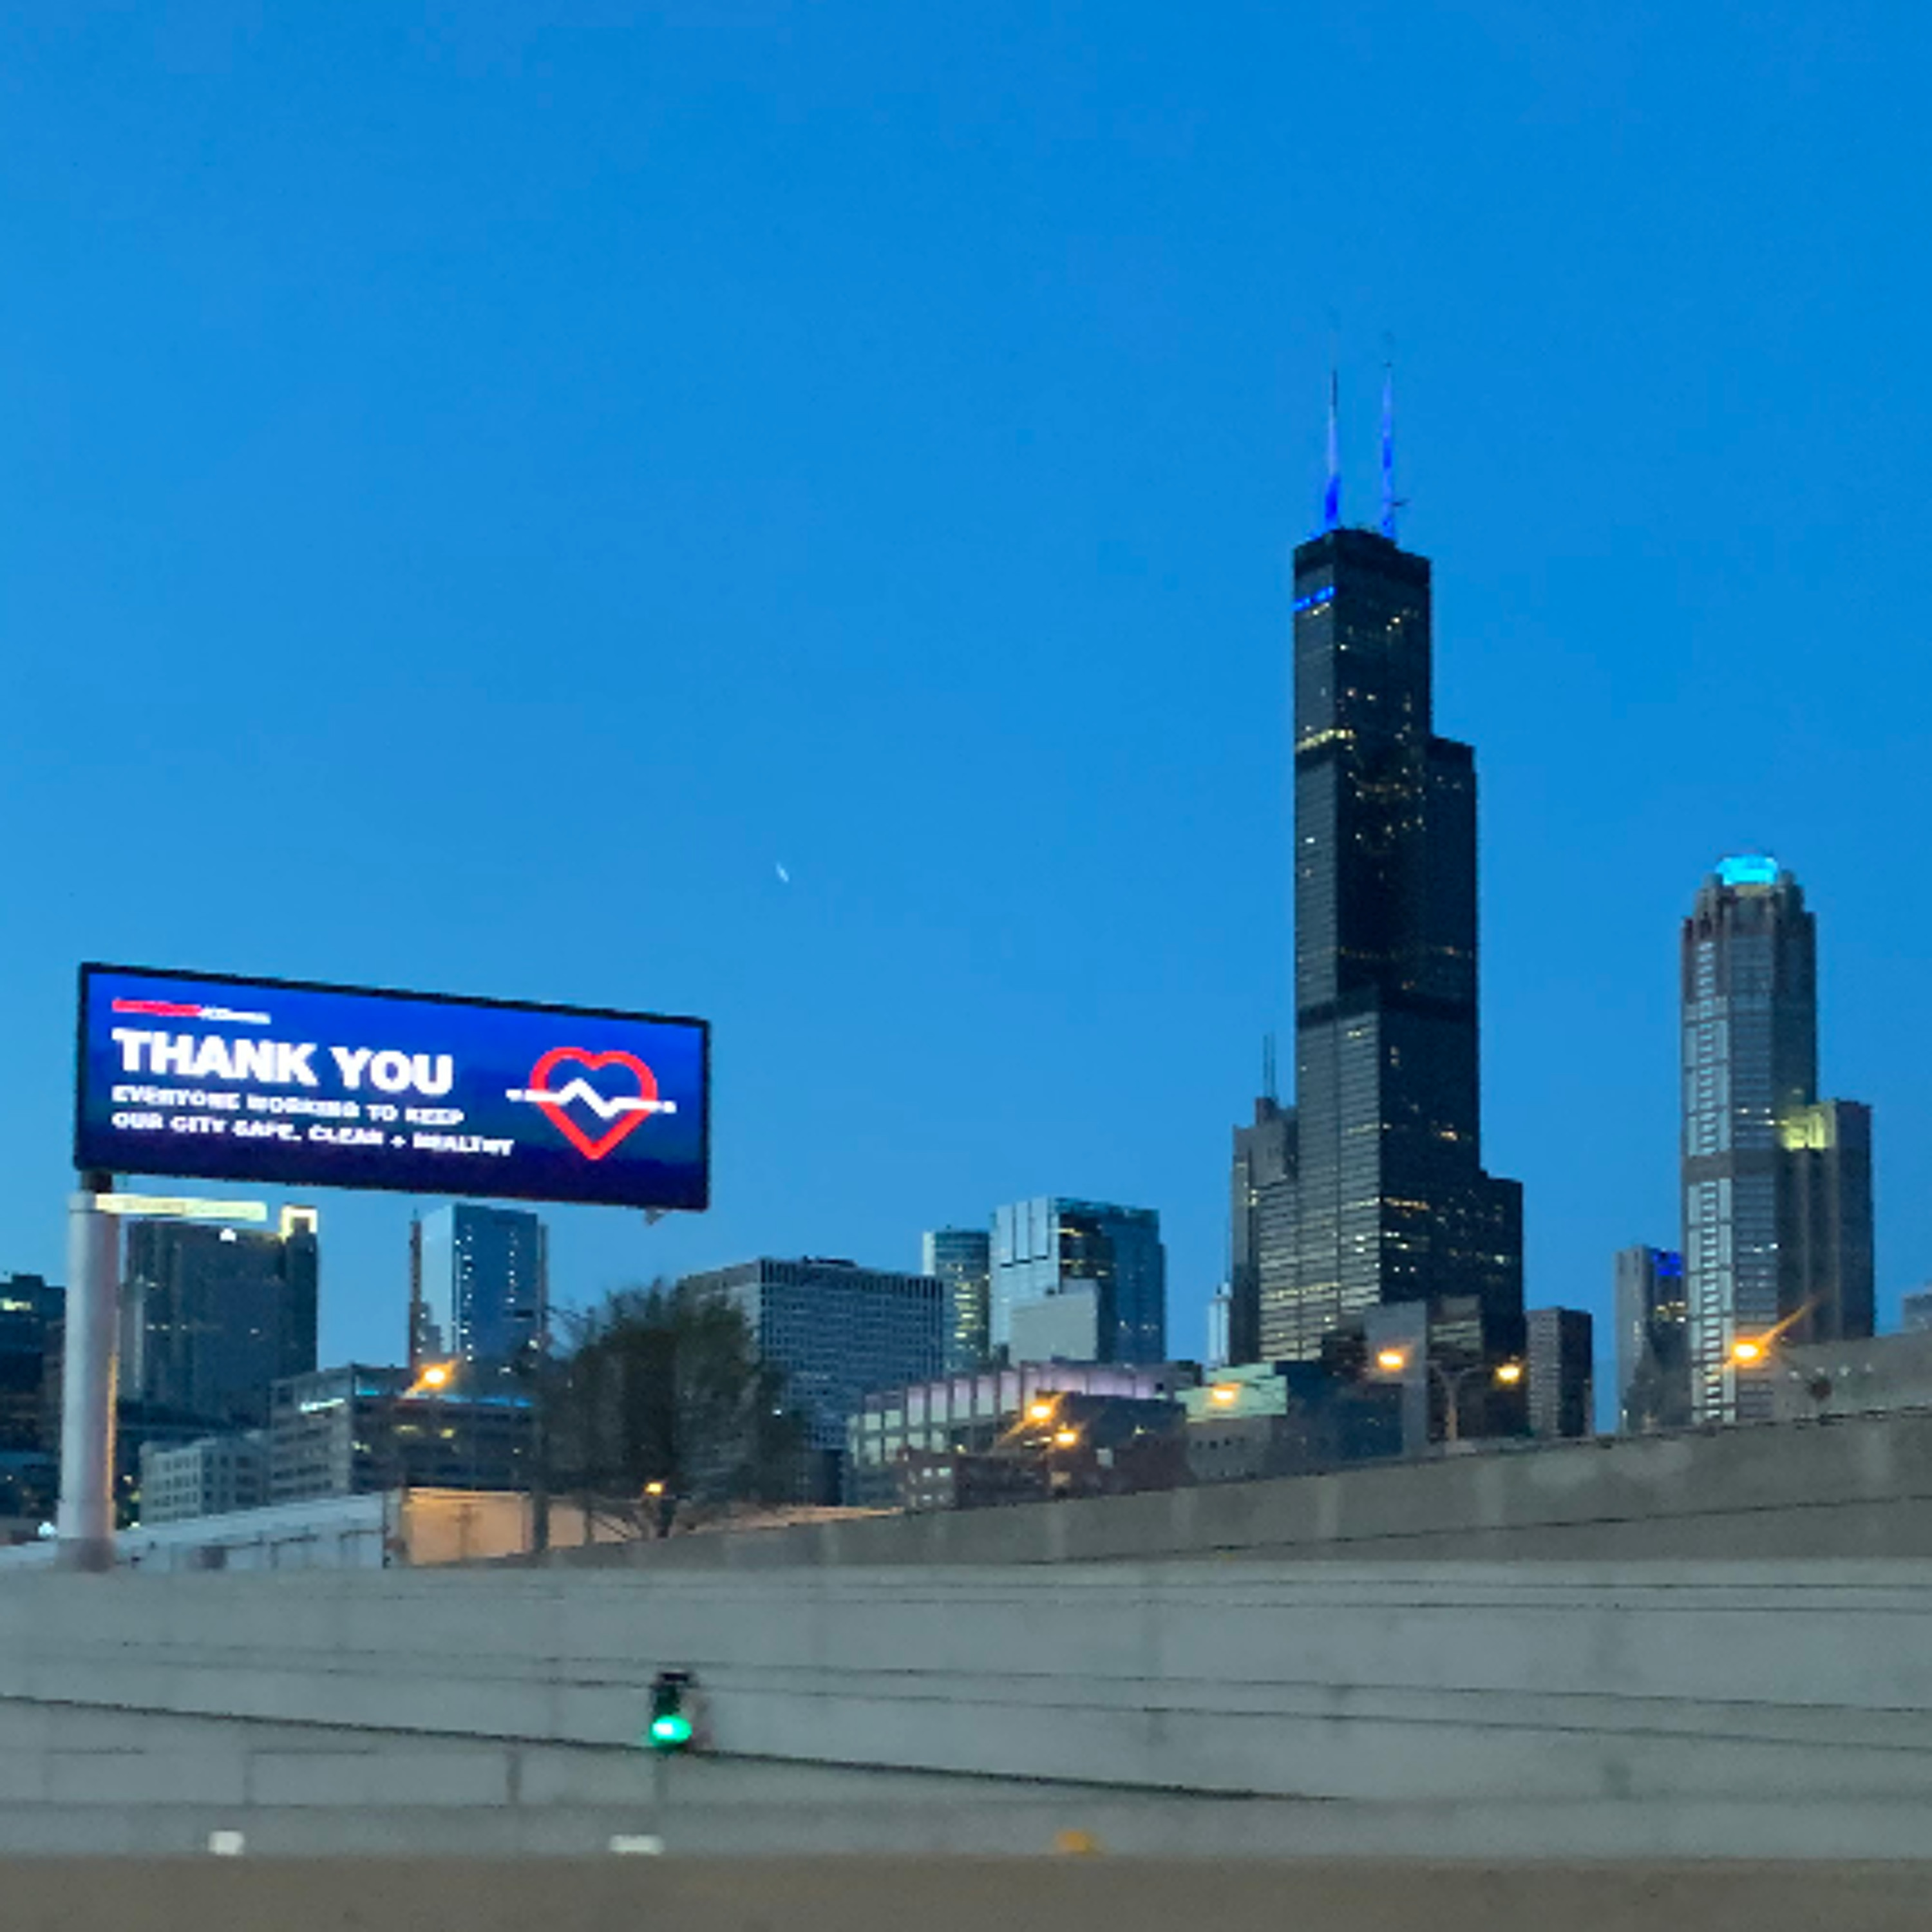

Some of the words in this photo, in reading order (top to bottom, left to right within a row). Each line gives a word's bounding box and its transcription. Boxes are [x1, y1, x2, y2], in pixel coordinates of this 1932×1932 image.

[112, 1027, 319, 1086] THANK
[329, 1046, 453, 1096] YOU
[111, 1084, 240, 1110] EVERYONE
[365, 1104, 399, 1121] TO
[111, 1112, 164, 1129] OUR
[169, 1115, 227, 1133] CITY
[308, 1124, 384, 1145] CLEAN
